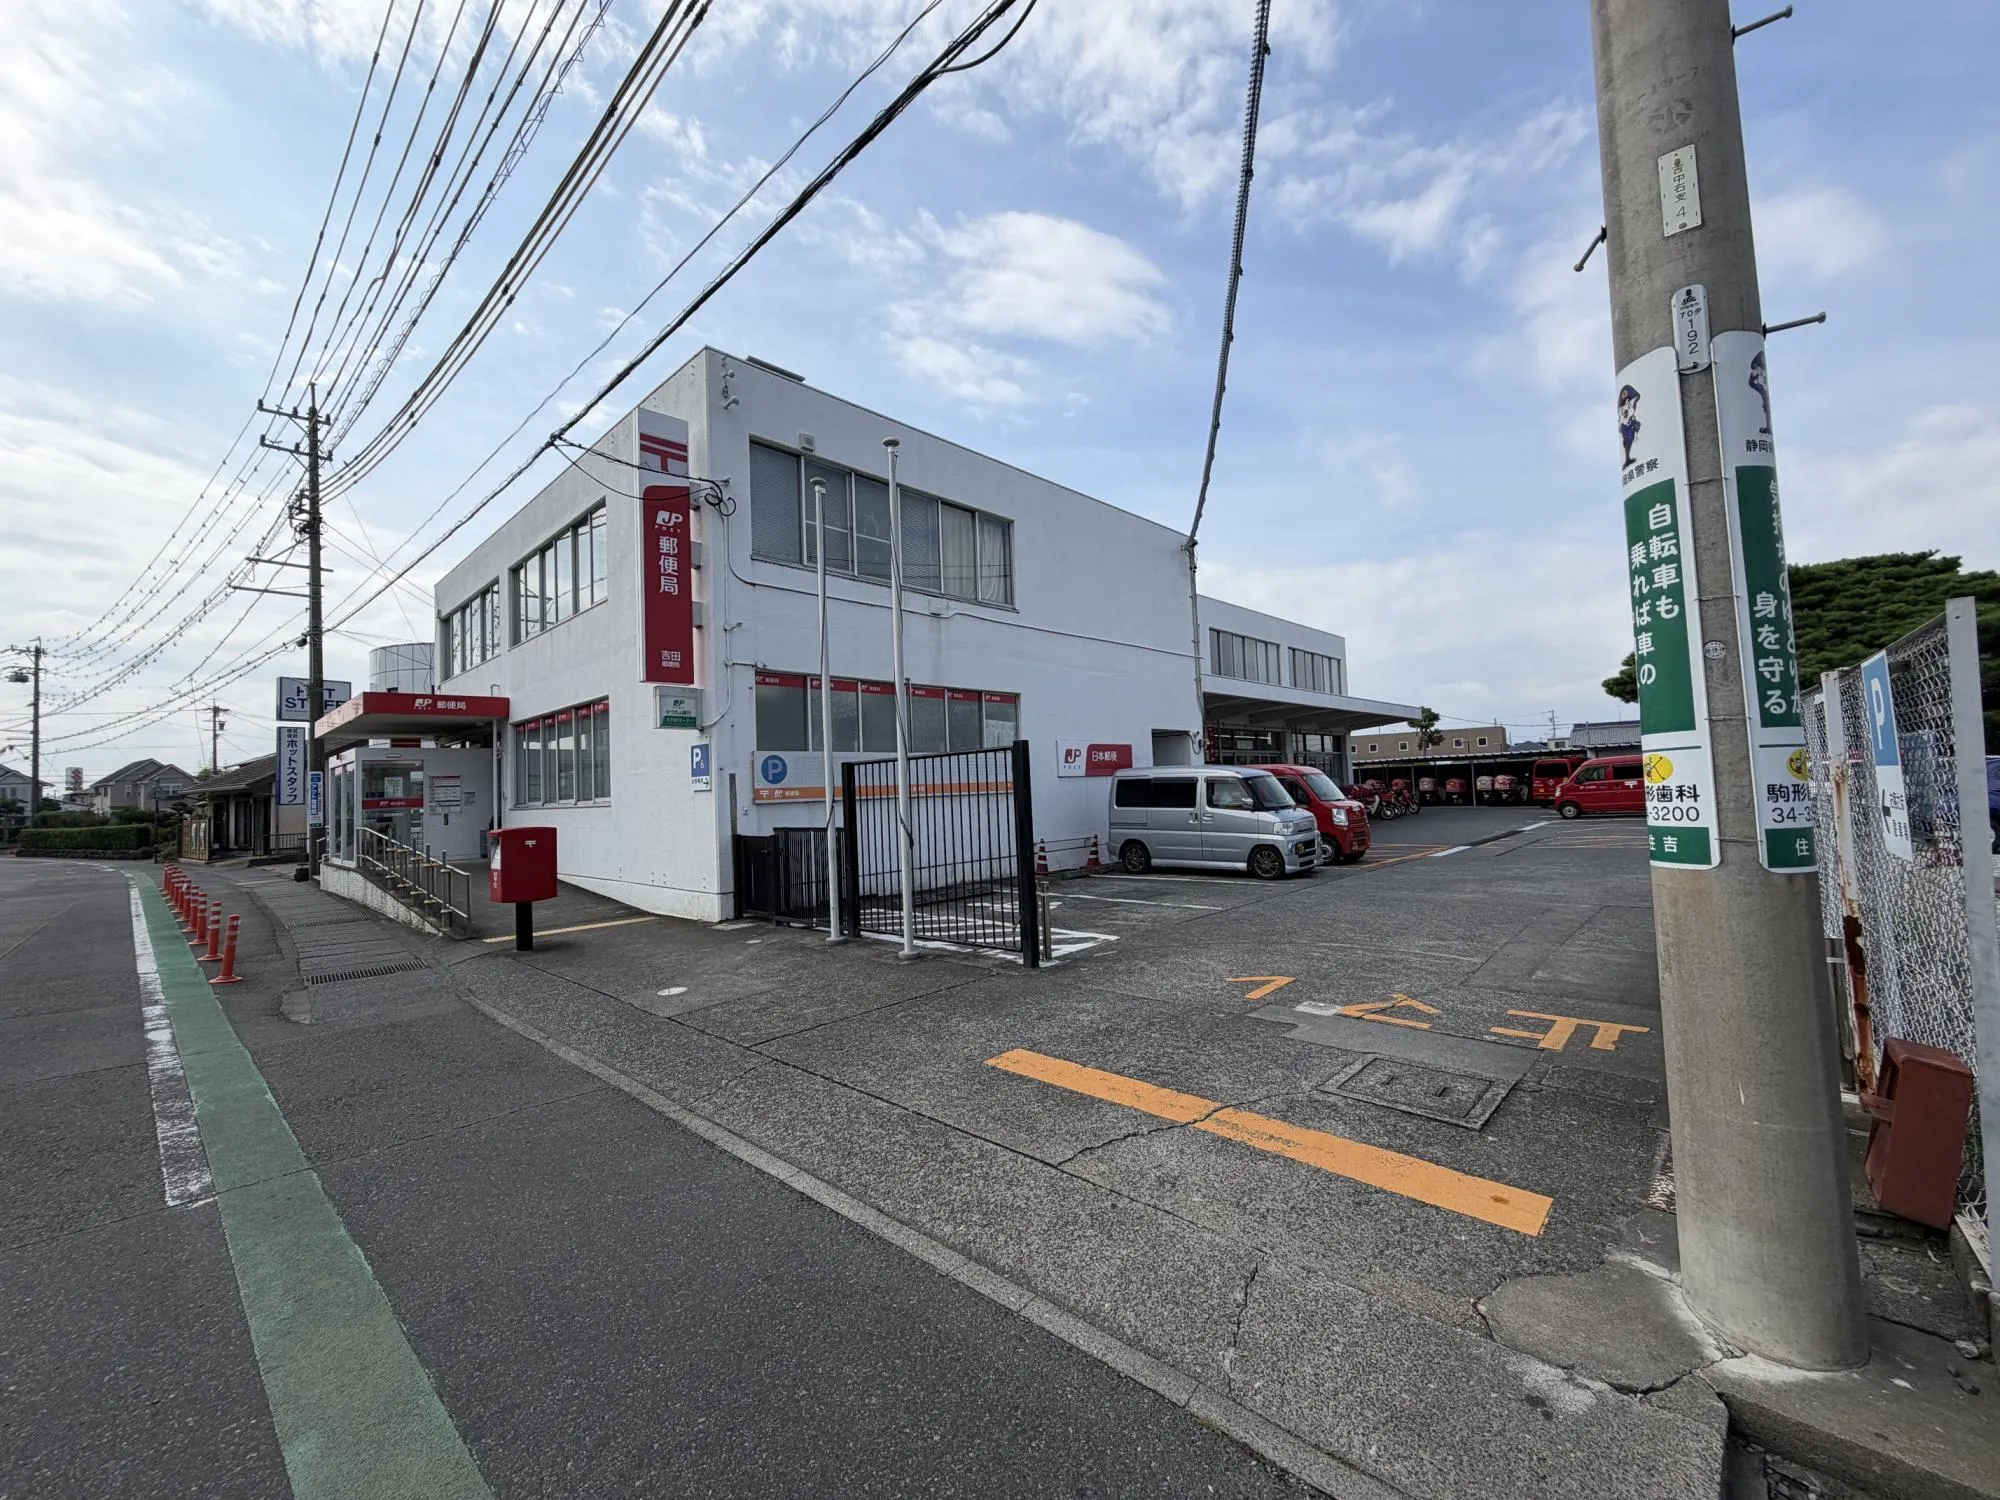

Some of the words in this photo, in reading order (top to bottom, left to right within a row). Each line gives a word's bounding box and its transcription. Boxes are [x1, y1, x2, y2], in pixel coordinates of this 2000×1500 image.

[1687, 319, 1699, 355] 192
[658, 536, 679, 596] 郵便局
[1648, 502, 1681, 620] 自転車も
[1630, 541, 1657, 686] 乗れば車の
[660, 650, 681, 661] 吉田
[1753, 591, 1788, 715] 身を守る
[285, 697, 346, 710] STFF
[296, 686, 336, 699] HT
[436, 700, 467, 710] 郵便局
[1870, 677, 1886, 750] P
[693, 748, 702, 769] P
[768, 759, 782, 781] P
[1091, 750, 1119, 762] 日本郵便
[286, 739, 298, 803] ホットスタッフ
